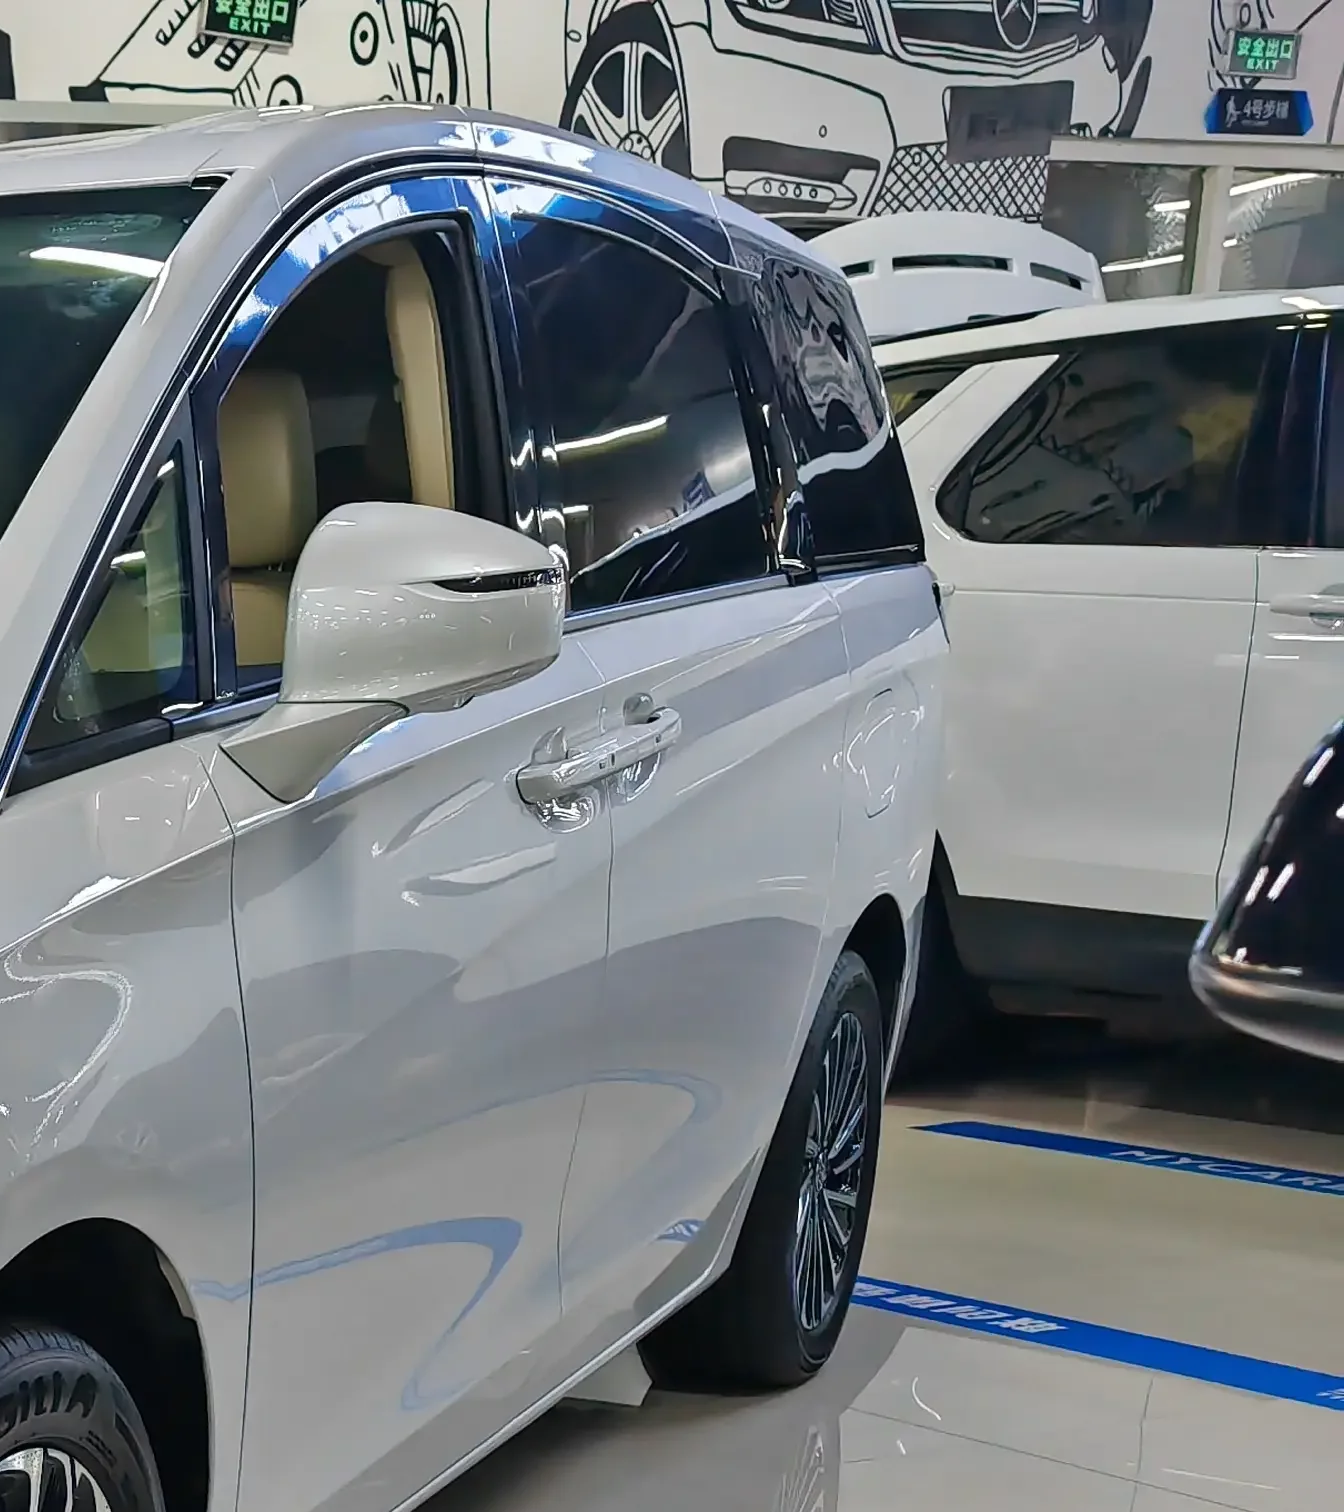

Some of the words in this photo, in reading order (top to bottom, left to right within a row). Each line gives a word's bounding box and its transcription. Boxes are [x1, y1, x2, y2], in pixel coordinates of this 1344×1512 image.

[215, 0, 289, 23] 安全出口
[229, 17, 270, 34] EXIT
[1237, 37, 1293, 59] 安全出口
[1246, 58, 1279, 71] EXIT
